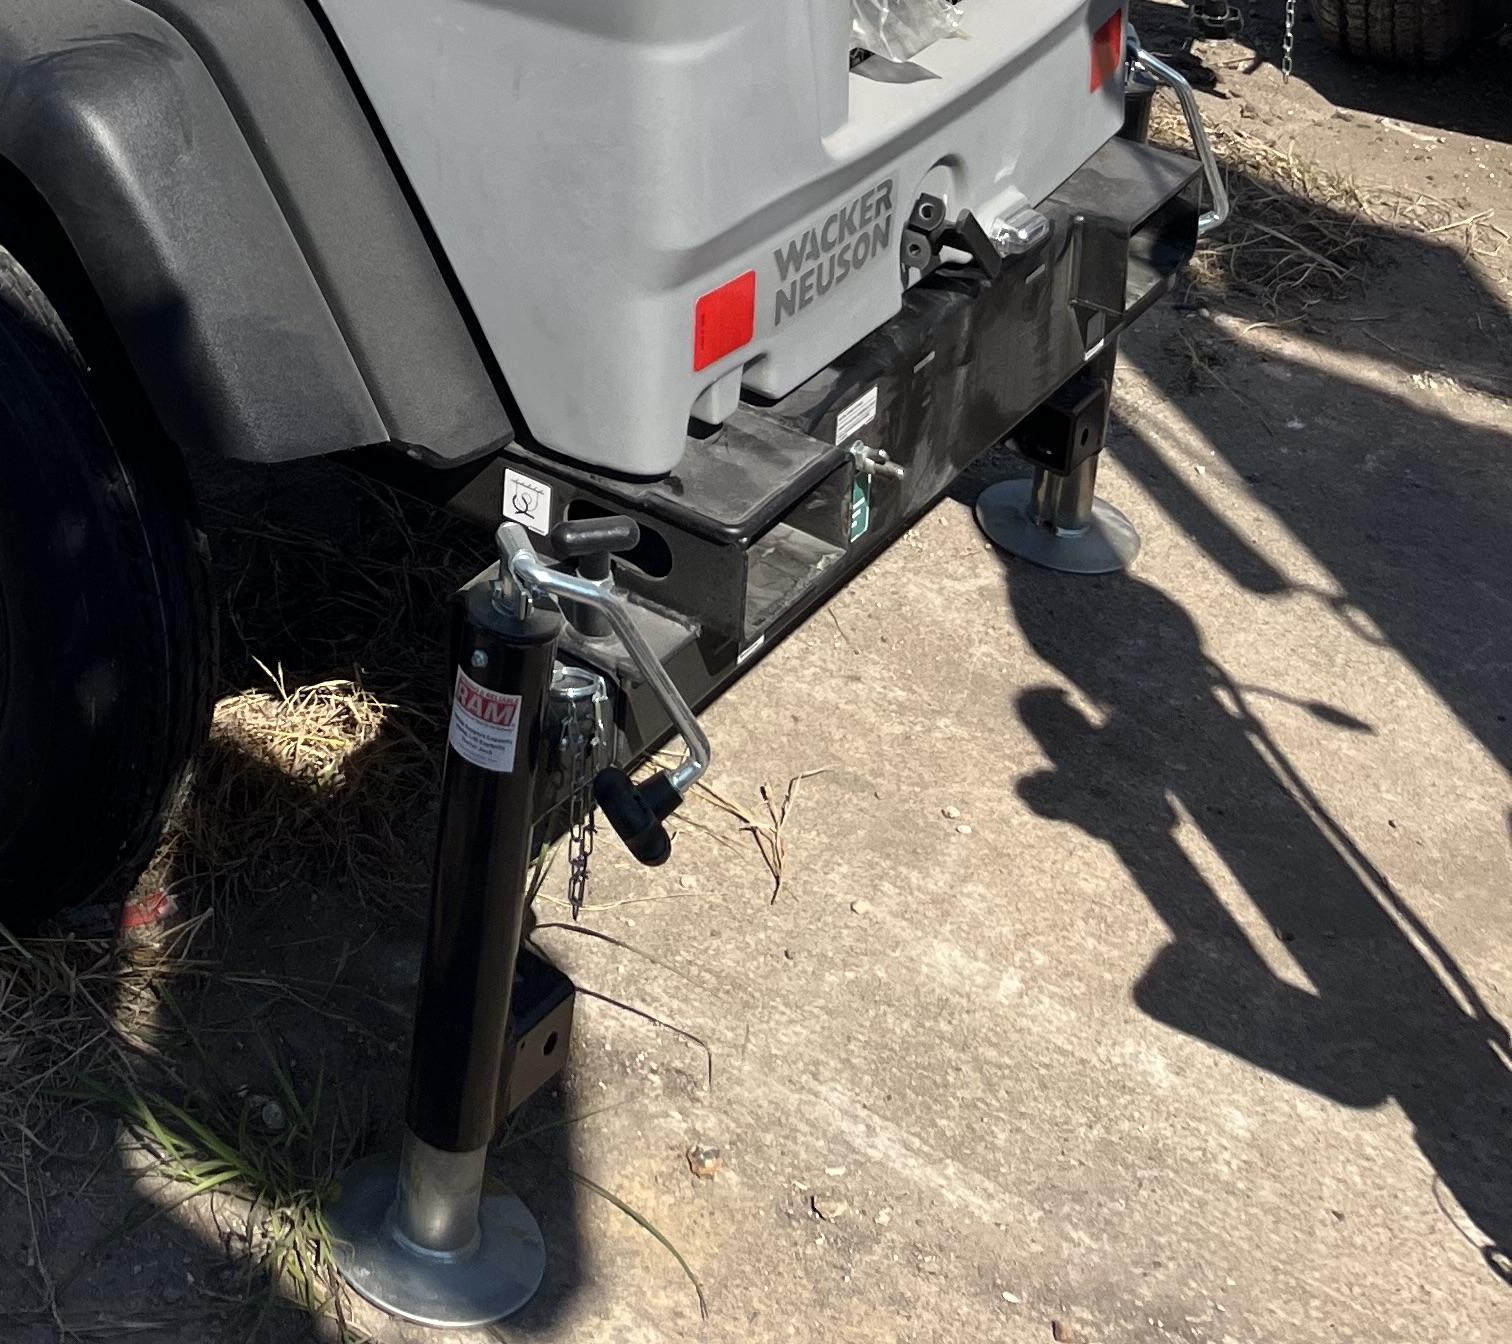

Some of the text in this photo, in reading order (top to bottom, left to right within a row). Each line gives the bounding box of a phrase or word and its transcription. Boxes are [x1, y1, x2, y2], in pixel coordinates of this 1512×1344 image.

[773, 178, 894, 282] WACKER
[774, 213, 892, 327] NEUSON
[456, 681, 515, 725] RAM
